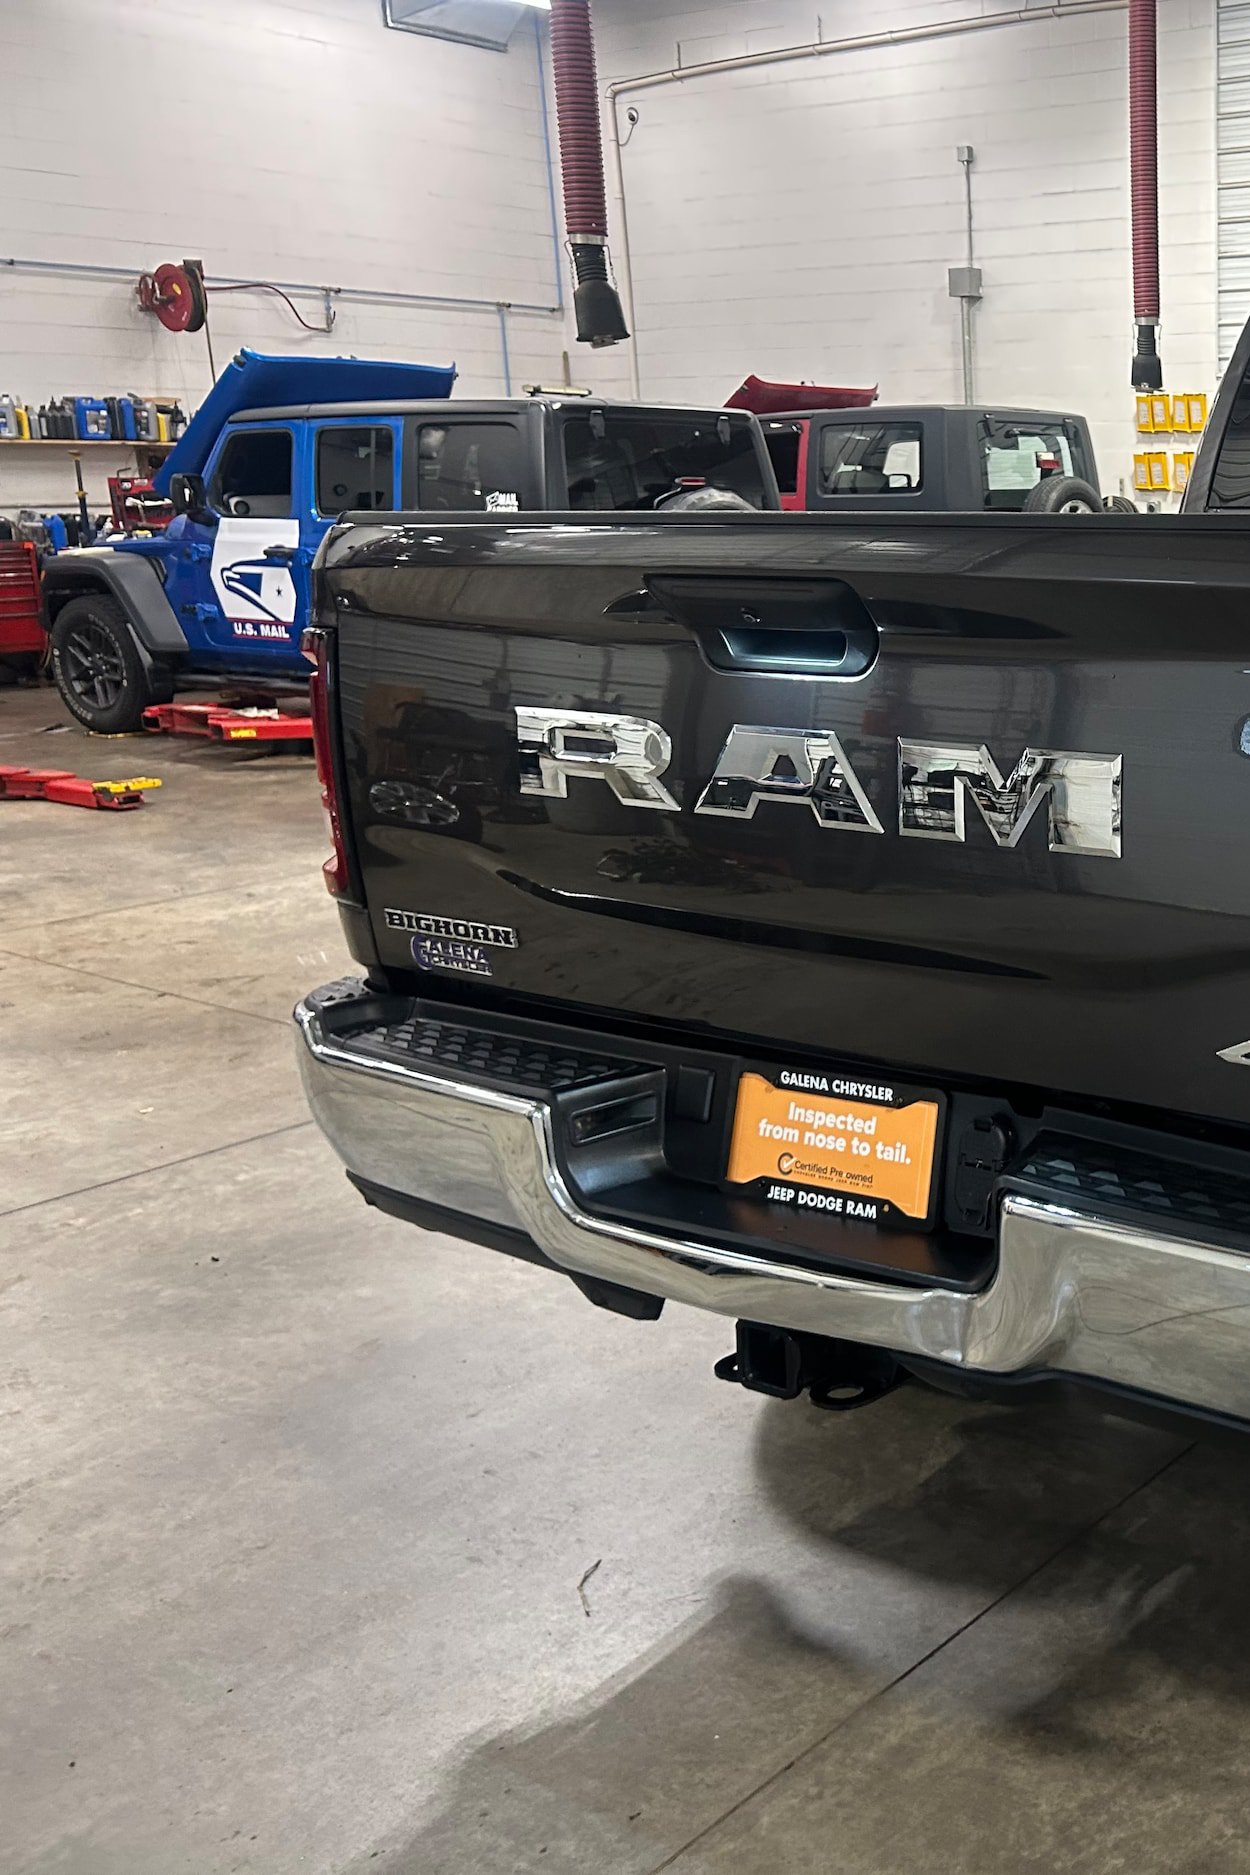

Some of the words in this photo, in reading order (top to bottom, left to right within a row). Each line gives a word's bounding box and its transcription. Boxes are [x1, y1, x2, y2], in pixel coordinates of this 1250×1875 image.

[234, 622, 258, 637] U.S.
[260, 623, 290, 639] MAIL
[514, 706, 1123, 859] RAM
[384, 907, 519, 949] BIGHORN
[410, 934, 490, 970] GALENA
[781, 1072, 829, 1092] GALENA
[832, 1080, 893, 1101] CHRYSLER
[788, 1102, 877, 1135] Inspected
[758, 1118, 800, 1144] from
[803, 1131, 847, 1152] nose
[851, 1136, 871, 1157] to
[875, 1140, 913, 1165] tail.
[794, 1160, 828, 1176] Certified
[845, 1170, 874, 1184] owned
[767, 1185, 796, 1202] JEEP
[797, 1191, 843, 1213] DODGE
[845, 1200, 878, 1220] RAM
